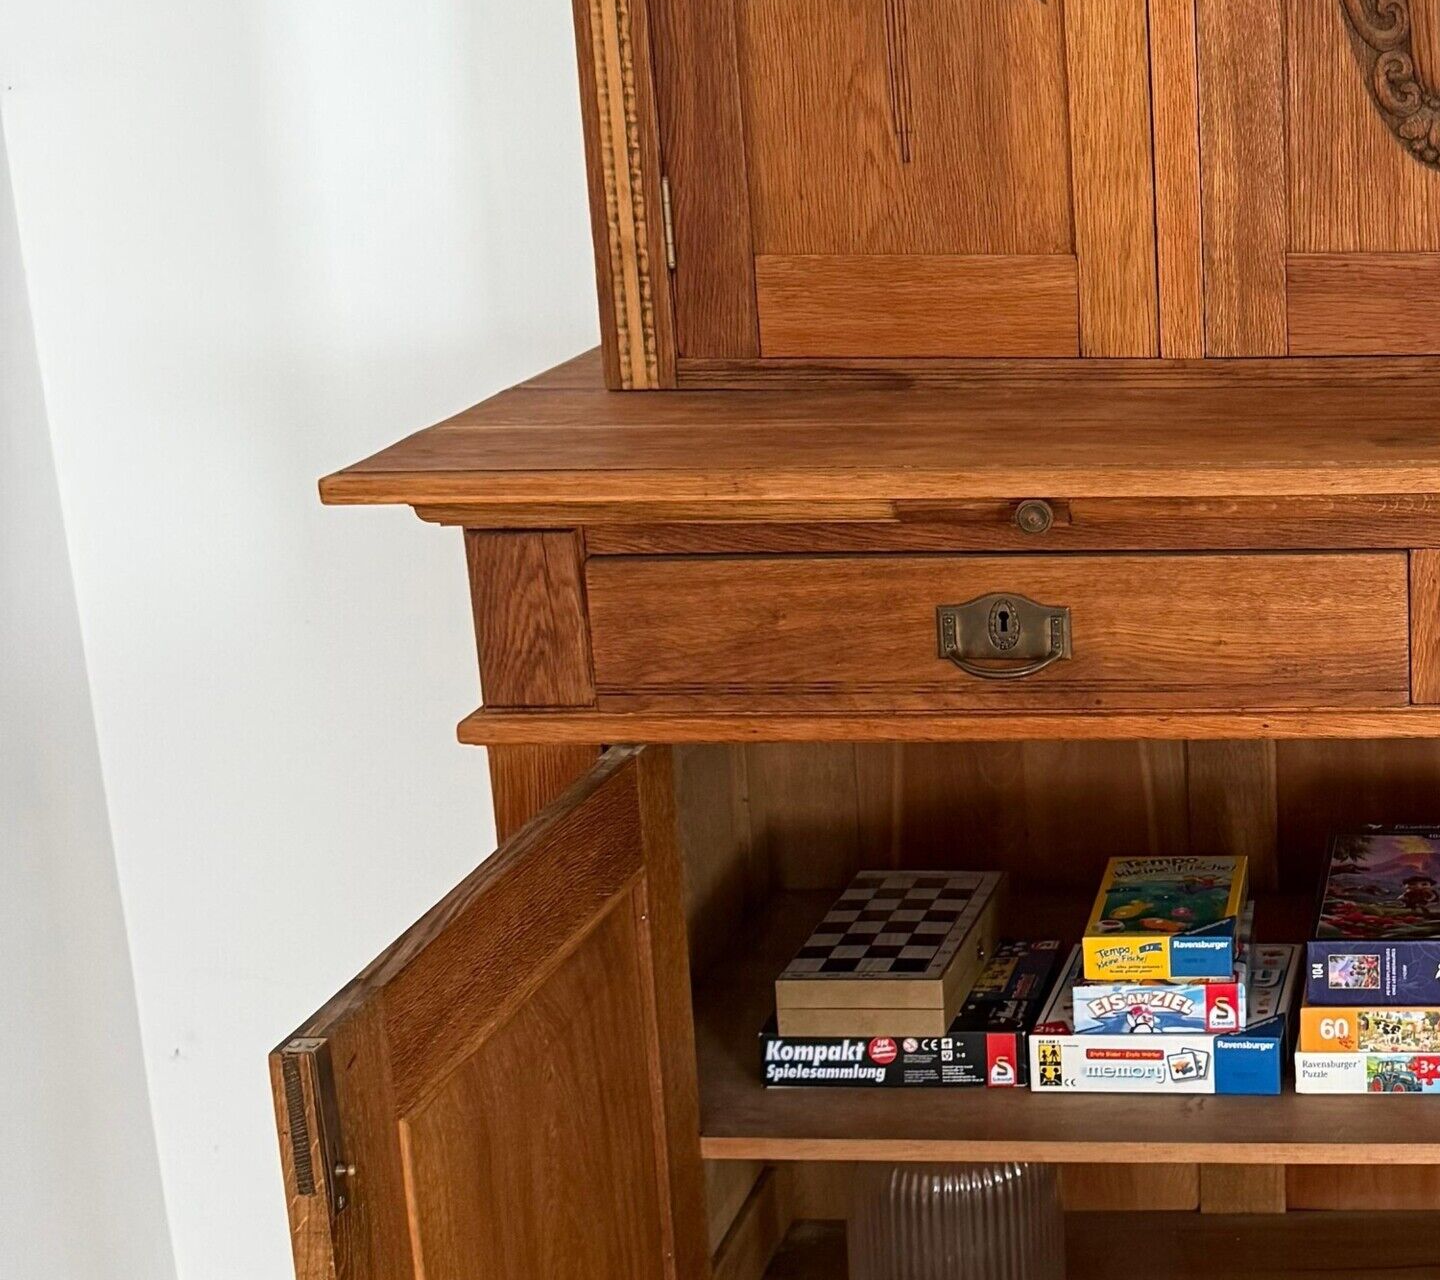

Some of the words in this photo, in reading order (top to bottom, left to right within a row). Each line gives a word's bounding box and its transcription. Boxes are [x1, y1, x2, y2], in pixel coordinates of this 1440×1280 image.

[1173, 940, 1229, 950] Ravensburger
[1312, 963, 1323, 979] 104
[1087, 993, 1127, 1017] EIS
[1127, 993, 1150, 1006] AM
[1150, 991, 1196, 1016] ZIEL
[1319, 1018, 1350, 1040] 60
[765, 1039, 866, 1067] Kompakt
[1217, 1040, 1275, 1051] Ravensburger
[1302, 1059, 1357, 1070] Ravensburger
[1419, 1060, 1435, 1074] 3+
[766, 1063, 886, 1083] Spielesammlung
[1086, 1064, 1168, 1085] memory
[1302, 1070, 1329, 1078] Puzzle
